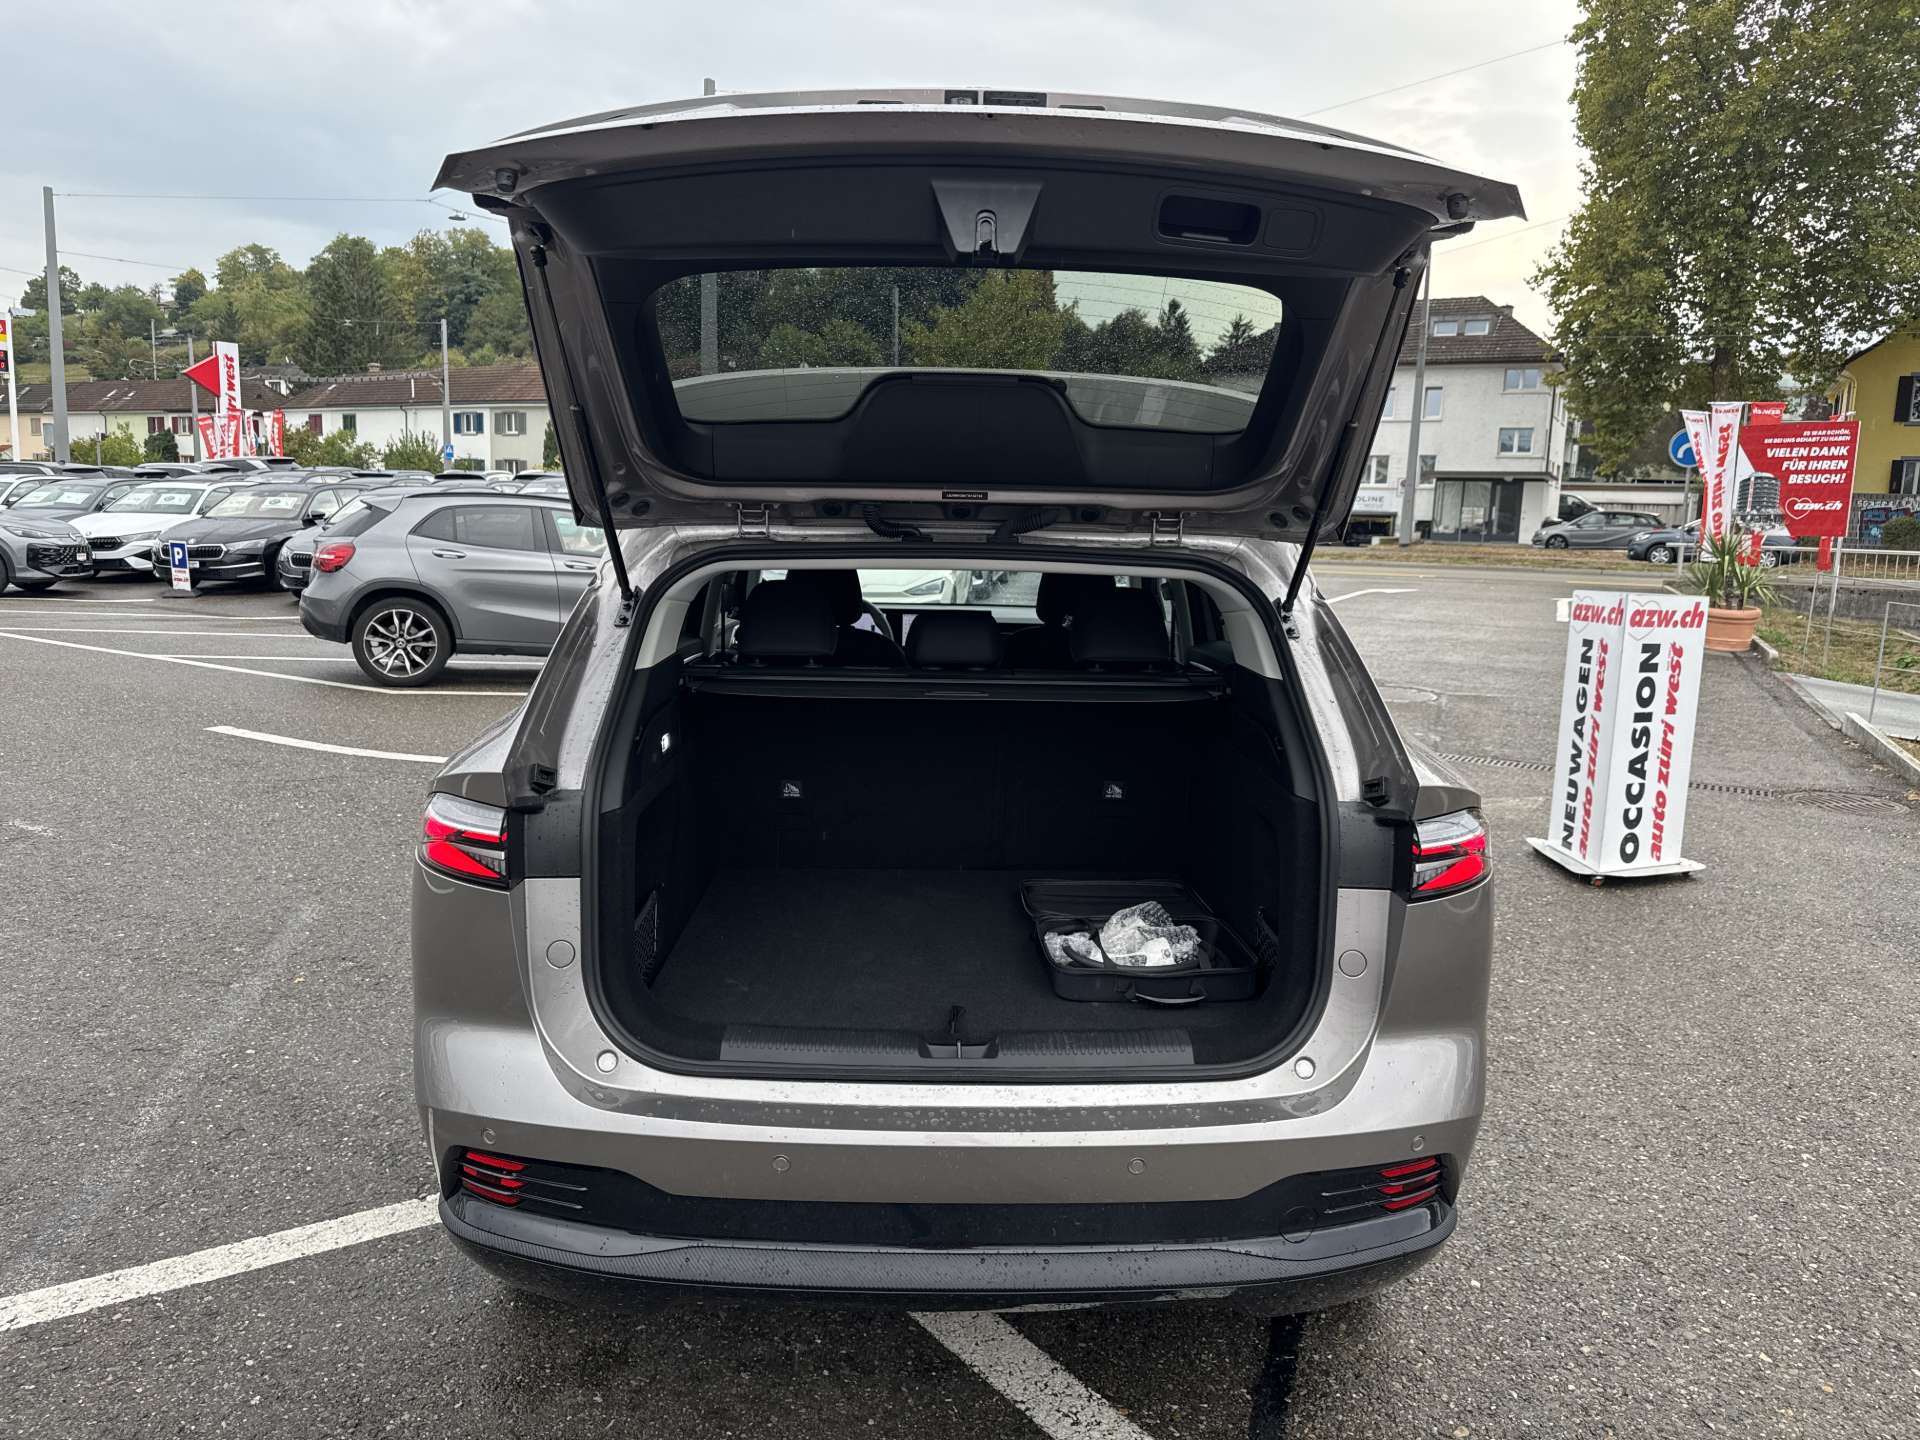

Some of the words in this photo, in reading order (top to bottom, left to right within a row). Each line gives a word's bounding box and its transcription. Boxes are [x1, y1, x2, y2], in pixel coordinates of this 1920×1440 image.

[224, 353, 236, 392] west
[1766, 447, 1808, 458] VIELEN
[1810, 446, 1850, 457] DANK
[1781, 458, 1808, 471] FÜR
[1808, 460, 1849, 471] IHREN
[1788, 473, 1847, 484] BESUCH!
[173, 547, 183, 565] P
[1572, 598, 1625, 627] azw.ch
[1629, 601, 1705, 629] azw.ch
[1593, 637, 1609, 713] west
[1664, 641, 1684, 716] west
[1561, 638, 1594, 851] NEUWAGEN
[1587, 713, 1601, 786] züri
[1619, 643, 1661, 864] OCCASION
[1656, 718, 1676, 790] züri
[1579, 786, 1593, 861] auto
[1651, 790, 1667, 862] auto
